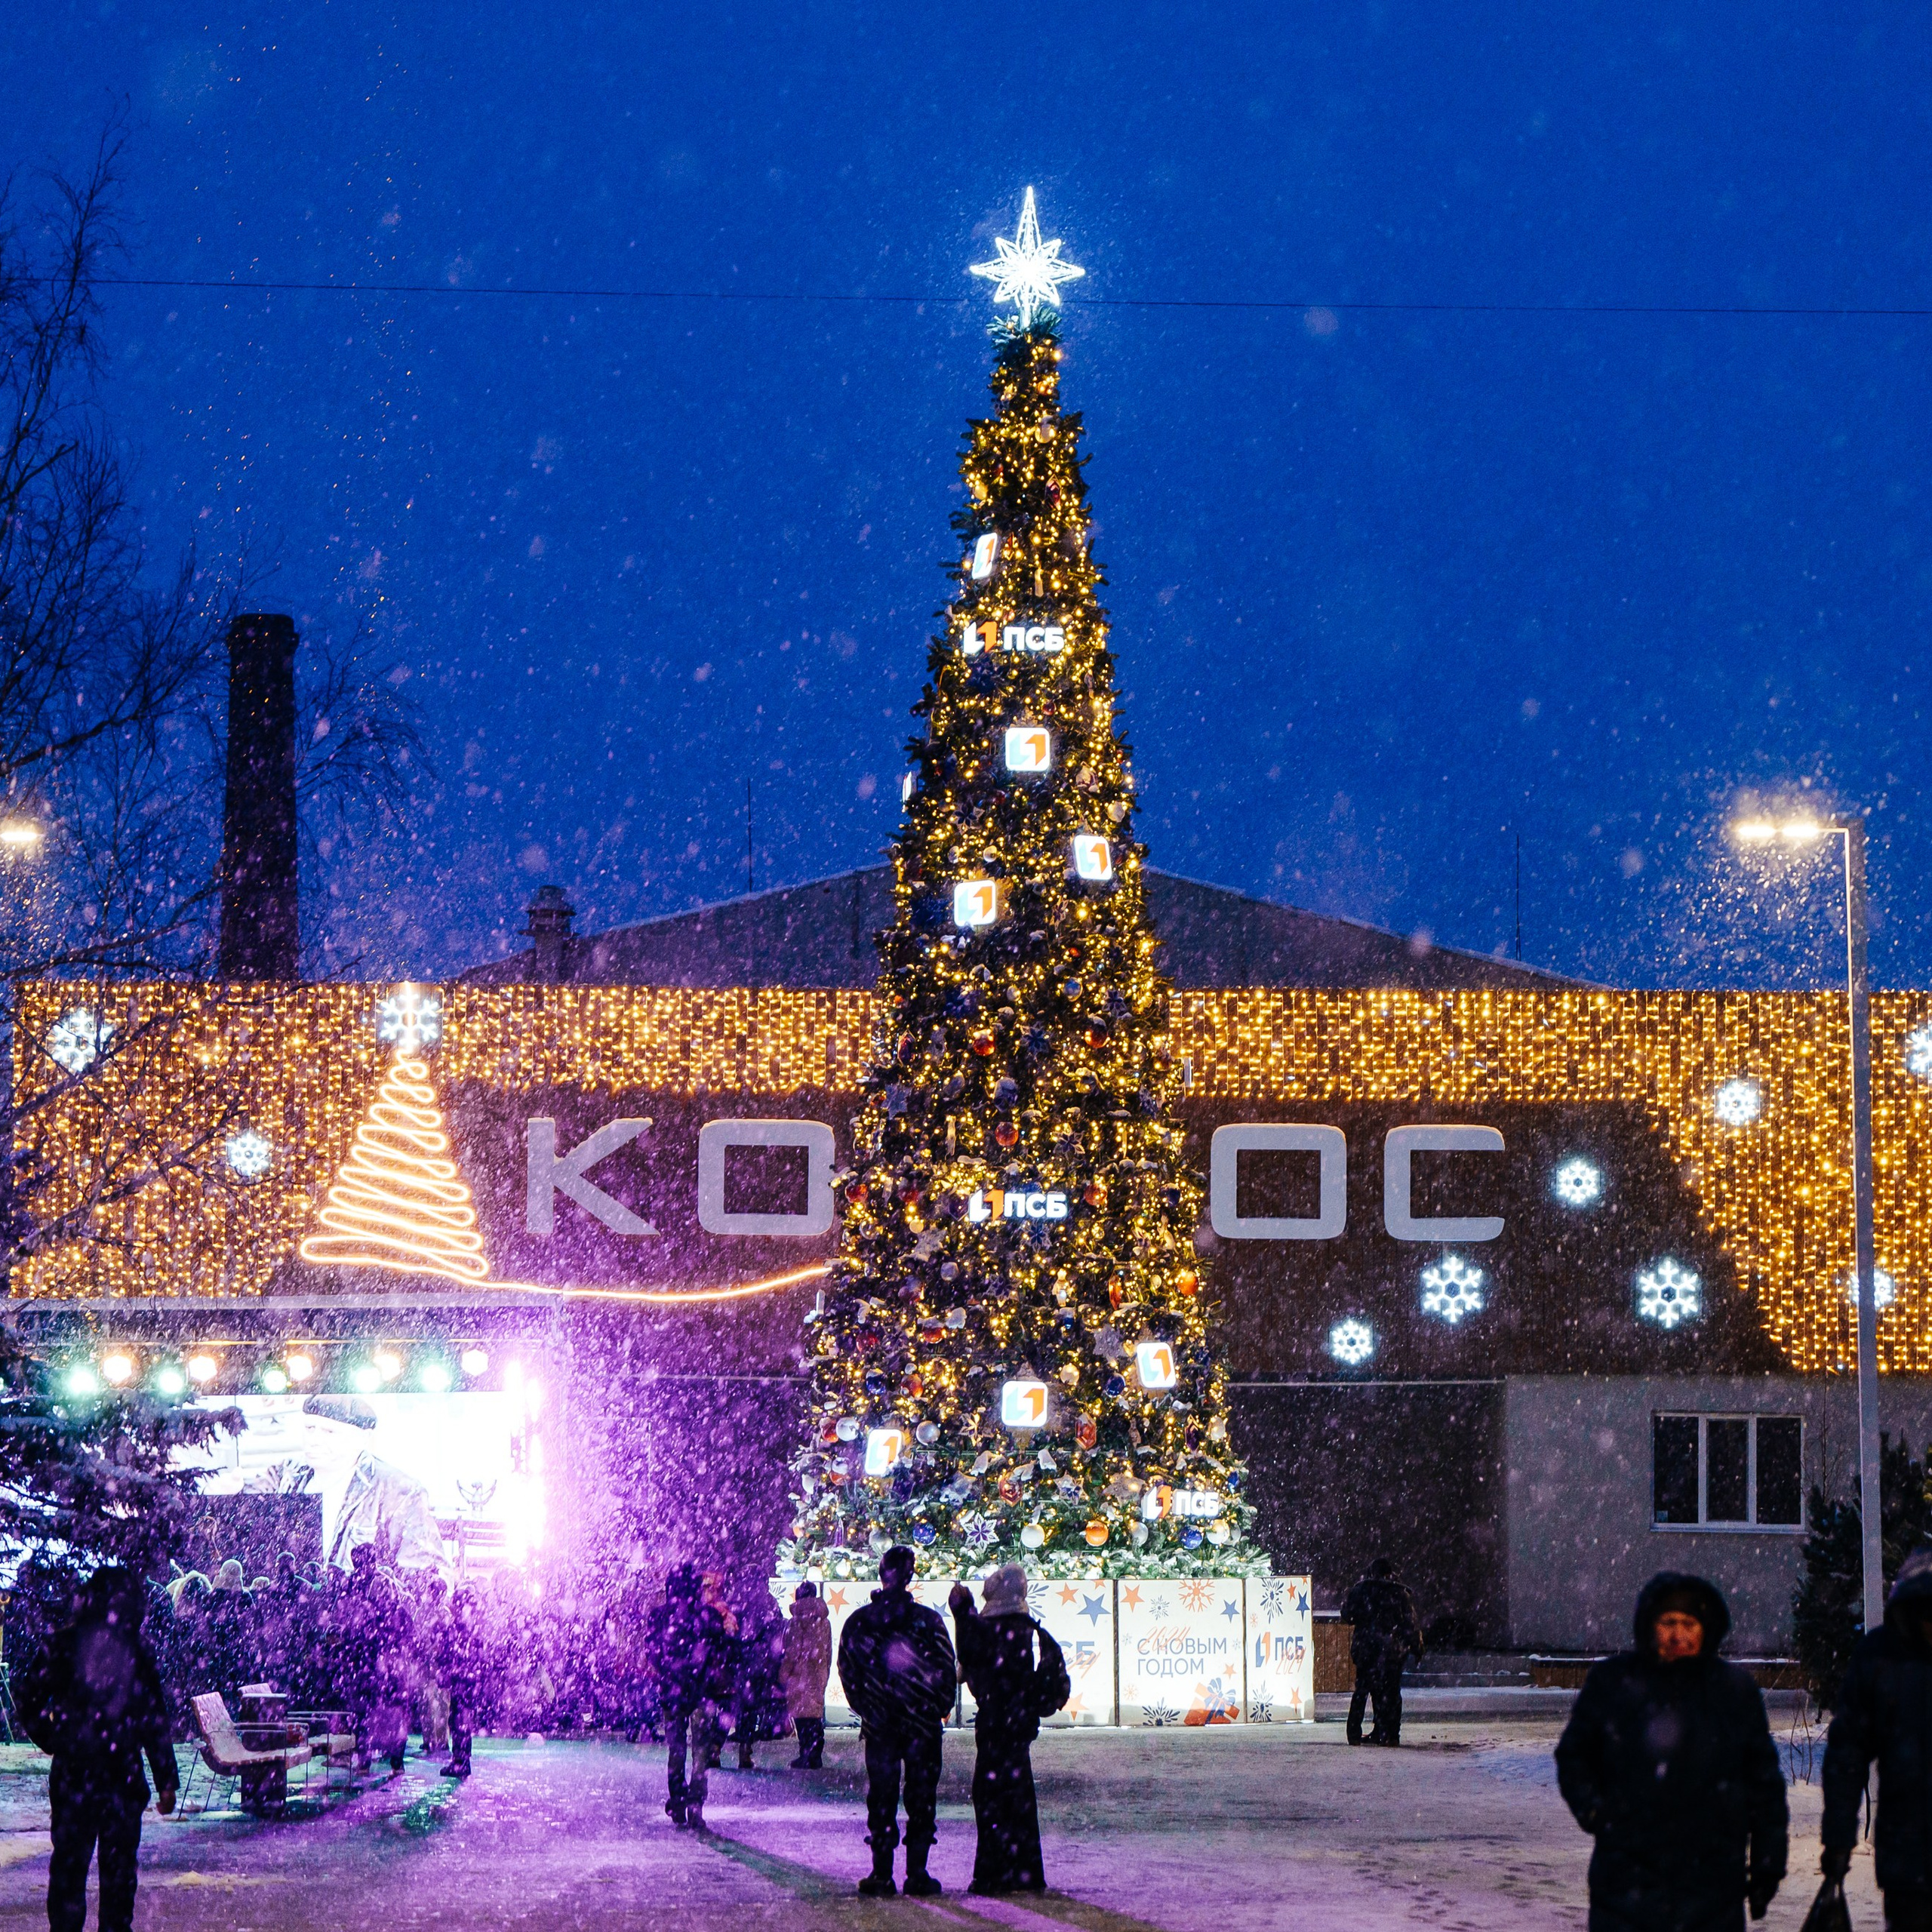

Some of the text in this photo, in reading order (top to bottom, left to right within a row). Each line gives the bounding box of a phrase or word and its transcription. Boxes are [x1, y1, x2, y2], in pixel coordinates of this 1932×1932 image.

[1003, 626, 1065, 651] ПСБ
[528, 1117, 1505, 1241] КООС
[1004, 1192, 1067, 1218] ПСБ
[1174, 1491, 1220, 1516] ПСБ
[1137, 1637, 1226, 1655] С НОВЫМ
[1275, 1635, 1305, 1661] ПСБ
[1137, 1657, 1204, 1678] ГОДОМ
